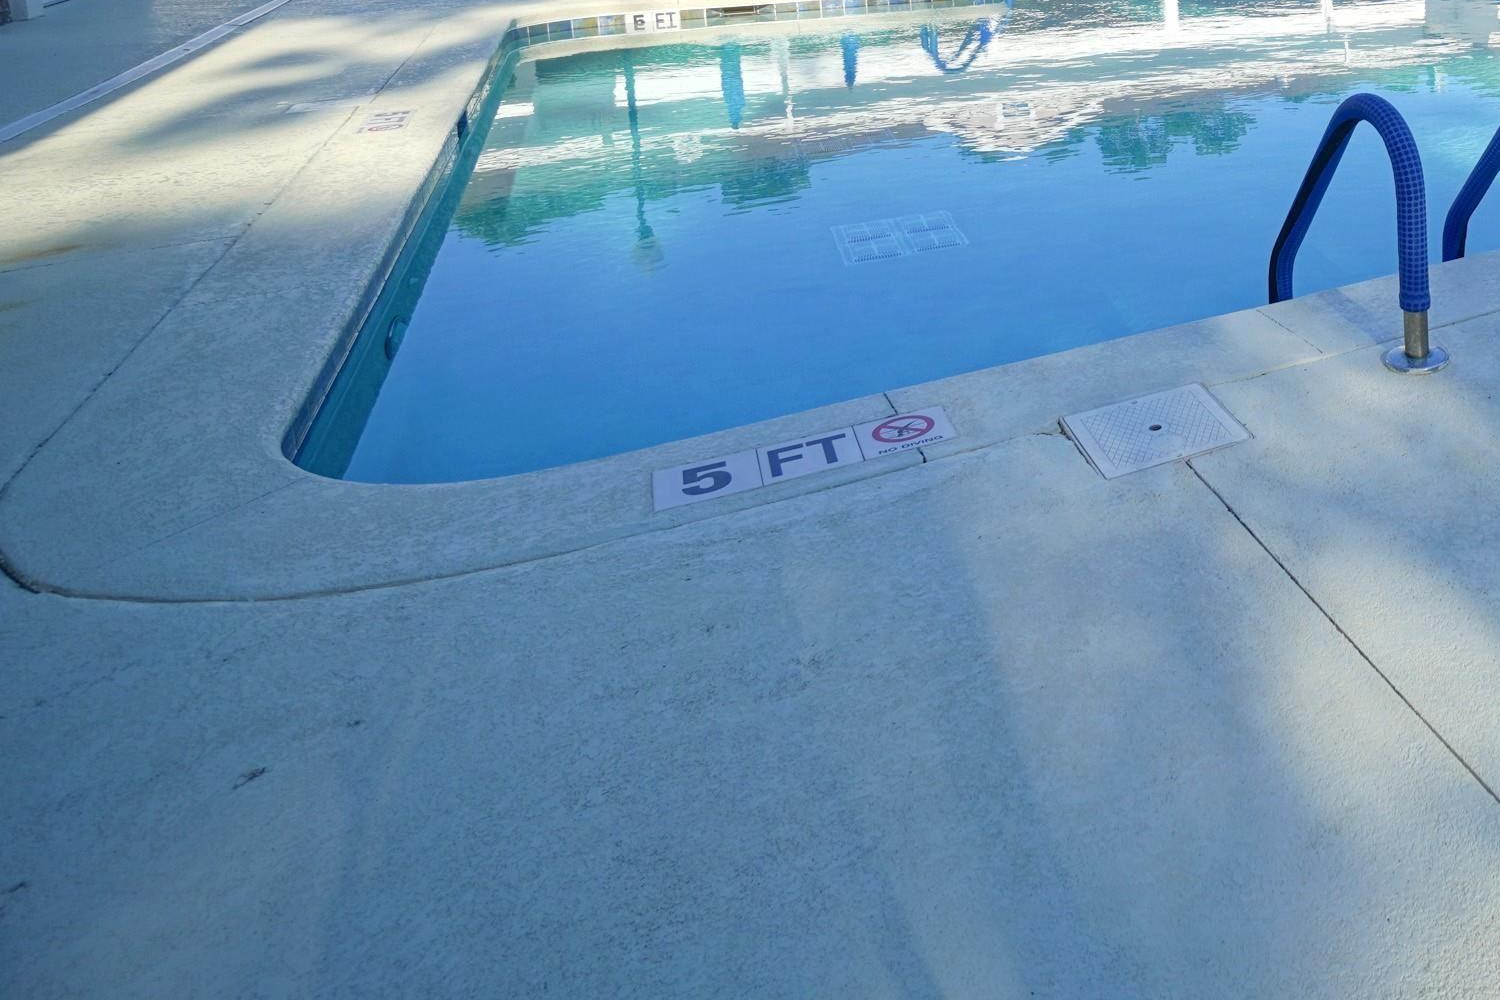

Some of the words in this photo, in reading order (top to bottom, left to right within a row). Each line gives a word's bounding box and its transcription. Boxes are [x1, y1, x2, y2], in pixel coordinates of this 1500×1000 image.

[682, 460, 732, 496] 5
[766, 432, 847, 478] FT
[878, 447, 897, 455] NO
[901, 435, 943, 449] DIVING
